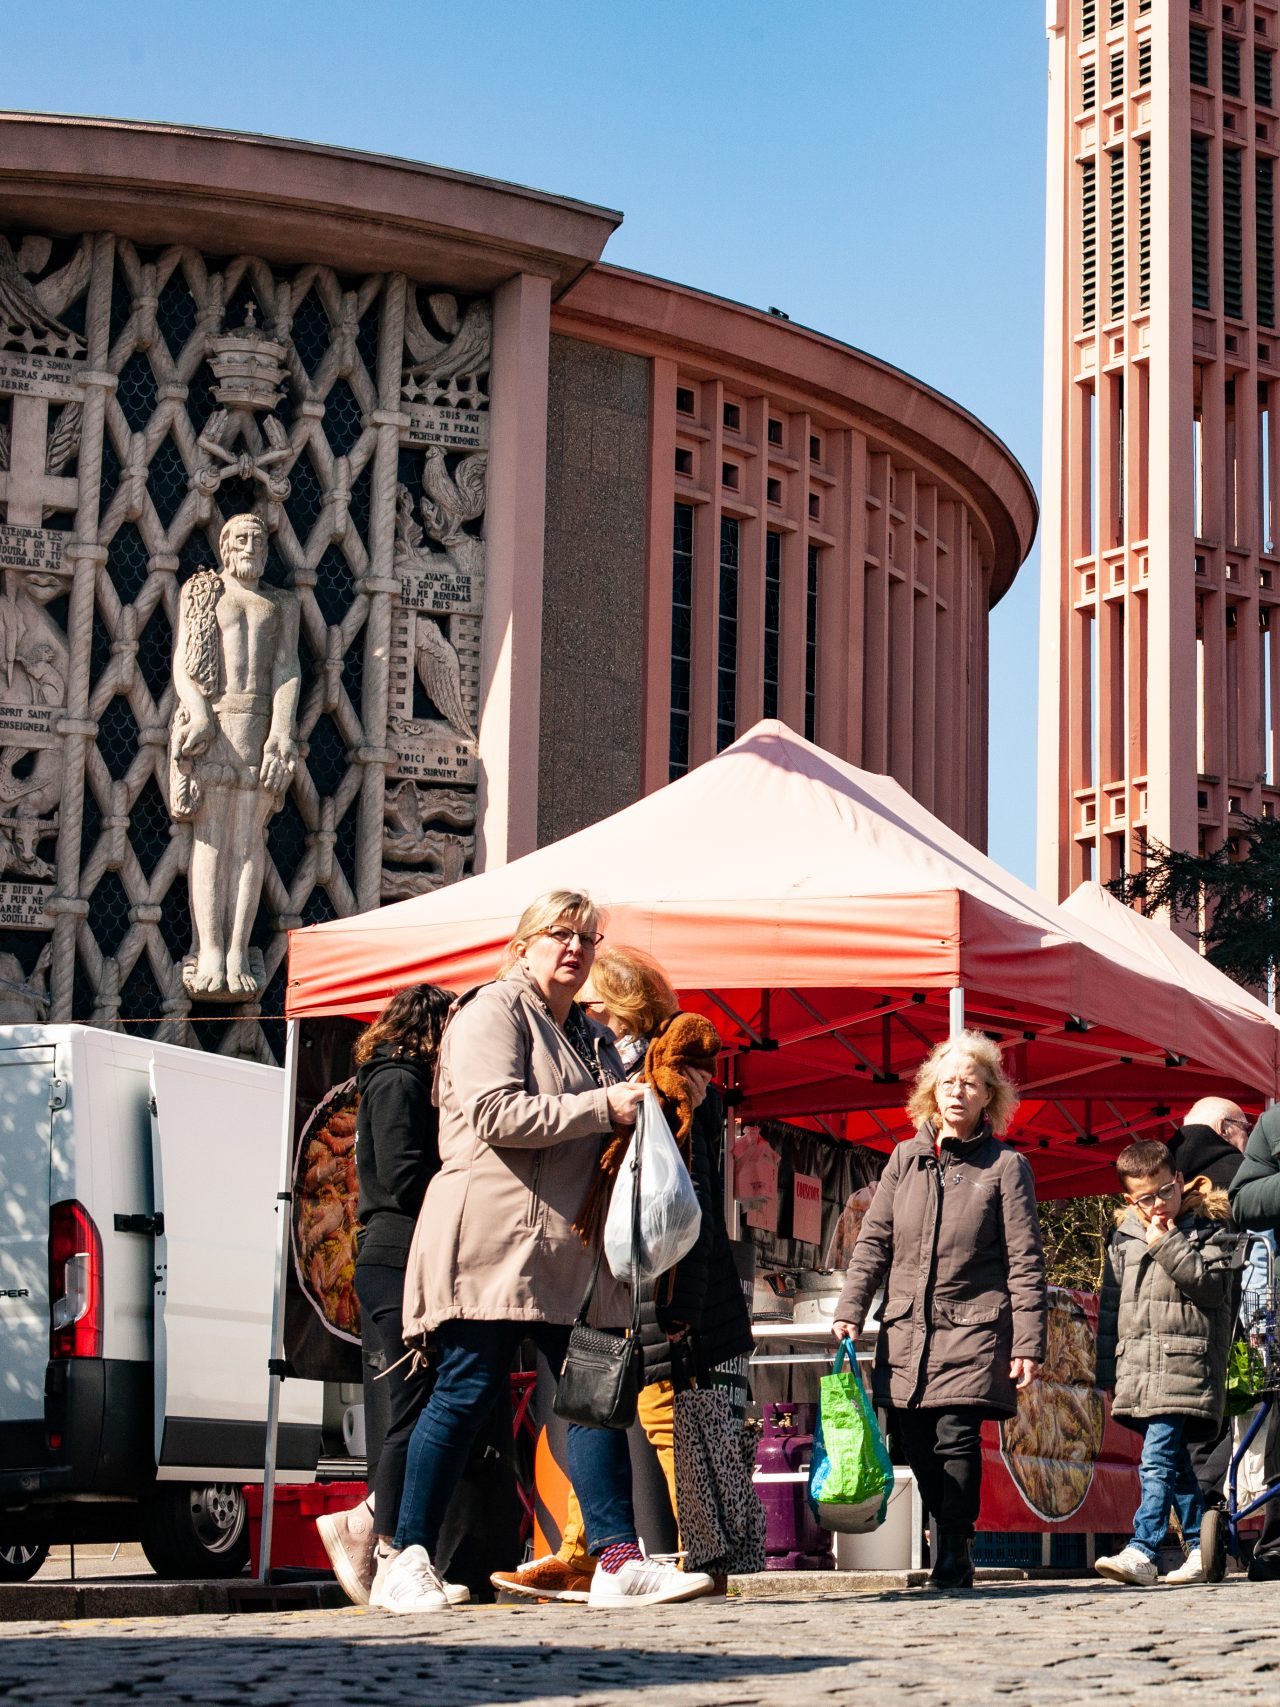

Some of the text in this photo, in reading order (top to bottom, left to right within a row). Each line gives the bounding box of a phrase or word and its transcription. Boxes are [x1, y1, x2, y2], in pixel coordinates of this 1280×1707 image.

[440, 410, 460, 420] SUIS
[410, 419, 479, 434] ET JE TE FERAI
[48, 531, 63, 541] LES
[16, 538, 27, 547] ET
[34, 540, 45, 549] ON
[51, 541, 62, 550] TE
[0, 546, 62, 560] DUIRA OU TU
[46, 560, 60, 570] PAS
[401, 579, 411, 587] LE
[440, 583, 471, 593] CHANTE
[400, 596, 425, 607] TROIS
[27, 709, 52, 720] SAINT
[0, 720, 51, 733] ENSEIGNERA
[396, 752, 425, 763] VOICI
[12, 885, 34, 895] DIEU
[11, 895, 27, 904] PUR
[32, 896, 43, 905] NE
[28, 906, 43, 915] PAS
